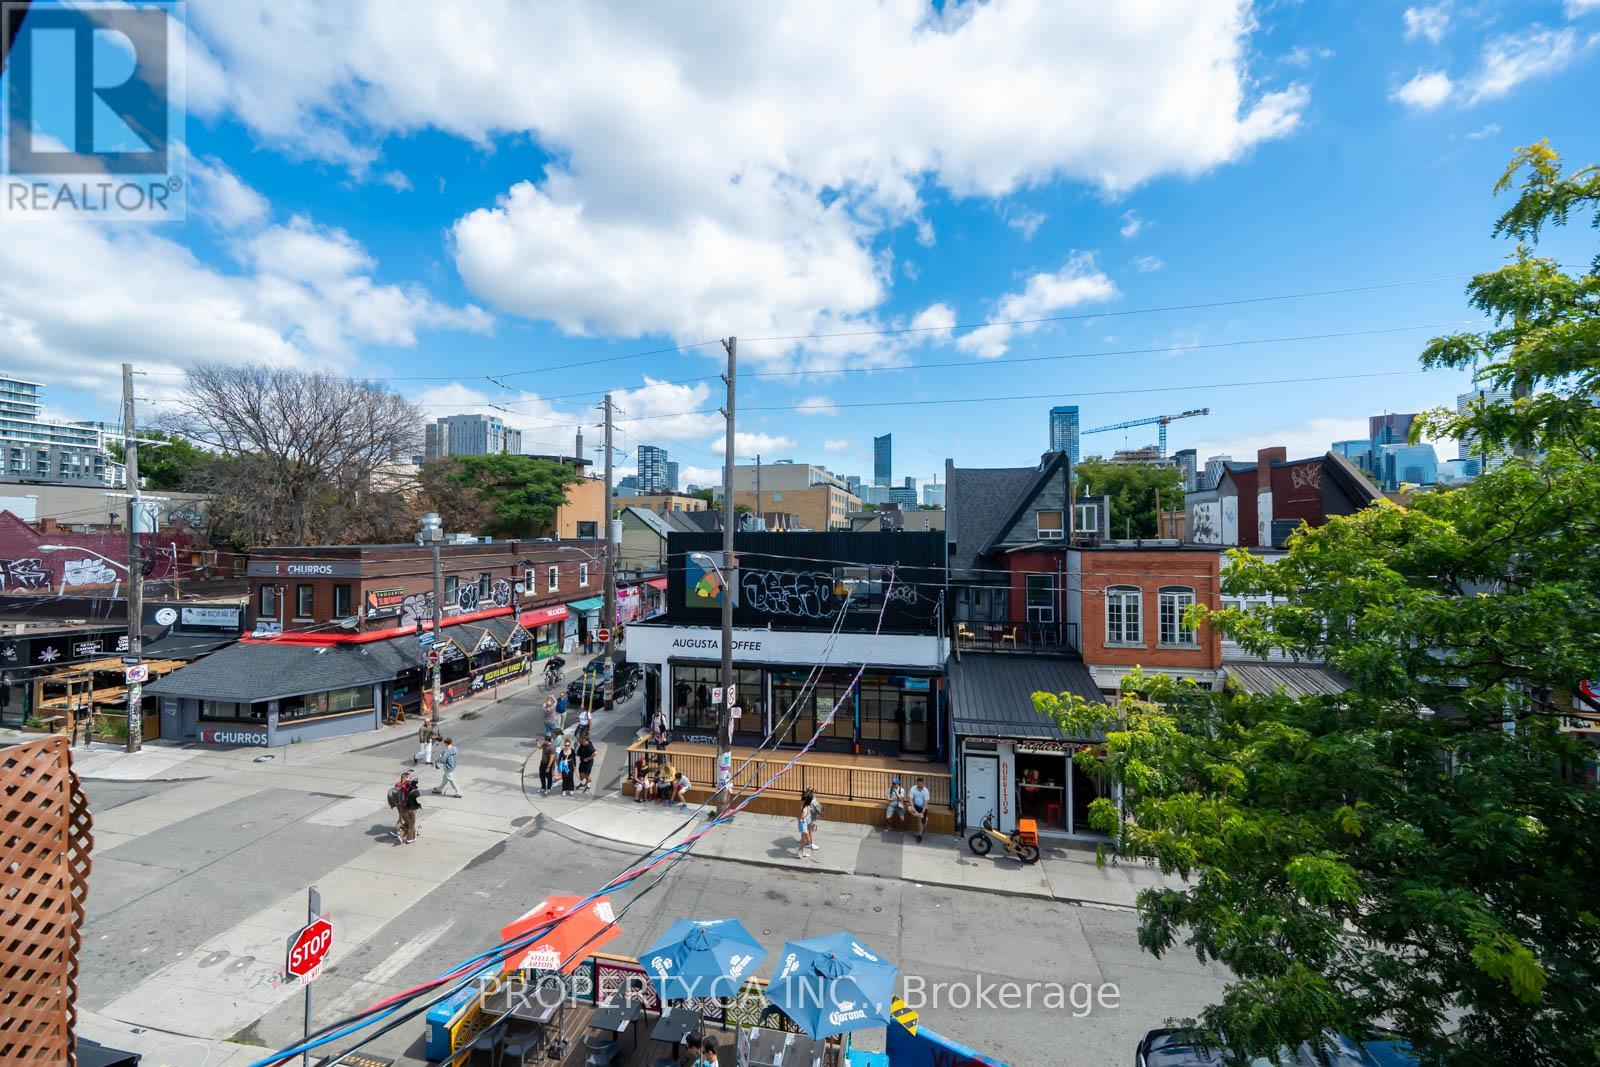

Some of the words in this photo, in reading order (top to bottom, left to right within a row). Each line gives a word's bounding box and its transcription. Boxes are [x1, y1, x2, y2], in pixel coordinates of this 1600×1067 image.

[287, 565, 332, 575] CHURROS
[672, 639, 718, 649] AUGUSTA
[731, 640, 762, 651] OFFEE
[213, 732, 267, 745] CHURROS
[292, 929, 330, 967] STOP
[530, 954, 555, 962] STELLA
[829, 1009, 867, 1026] Corona
